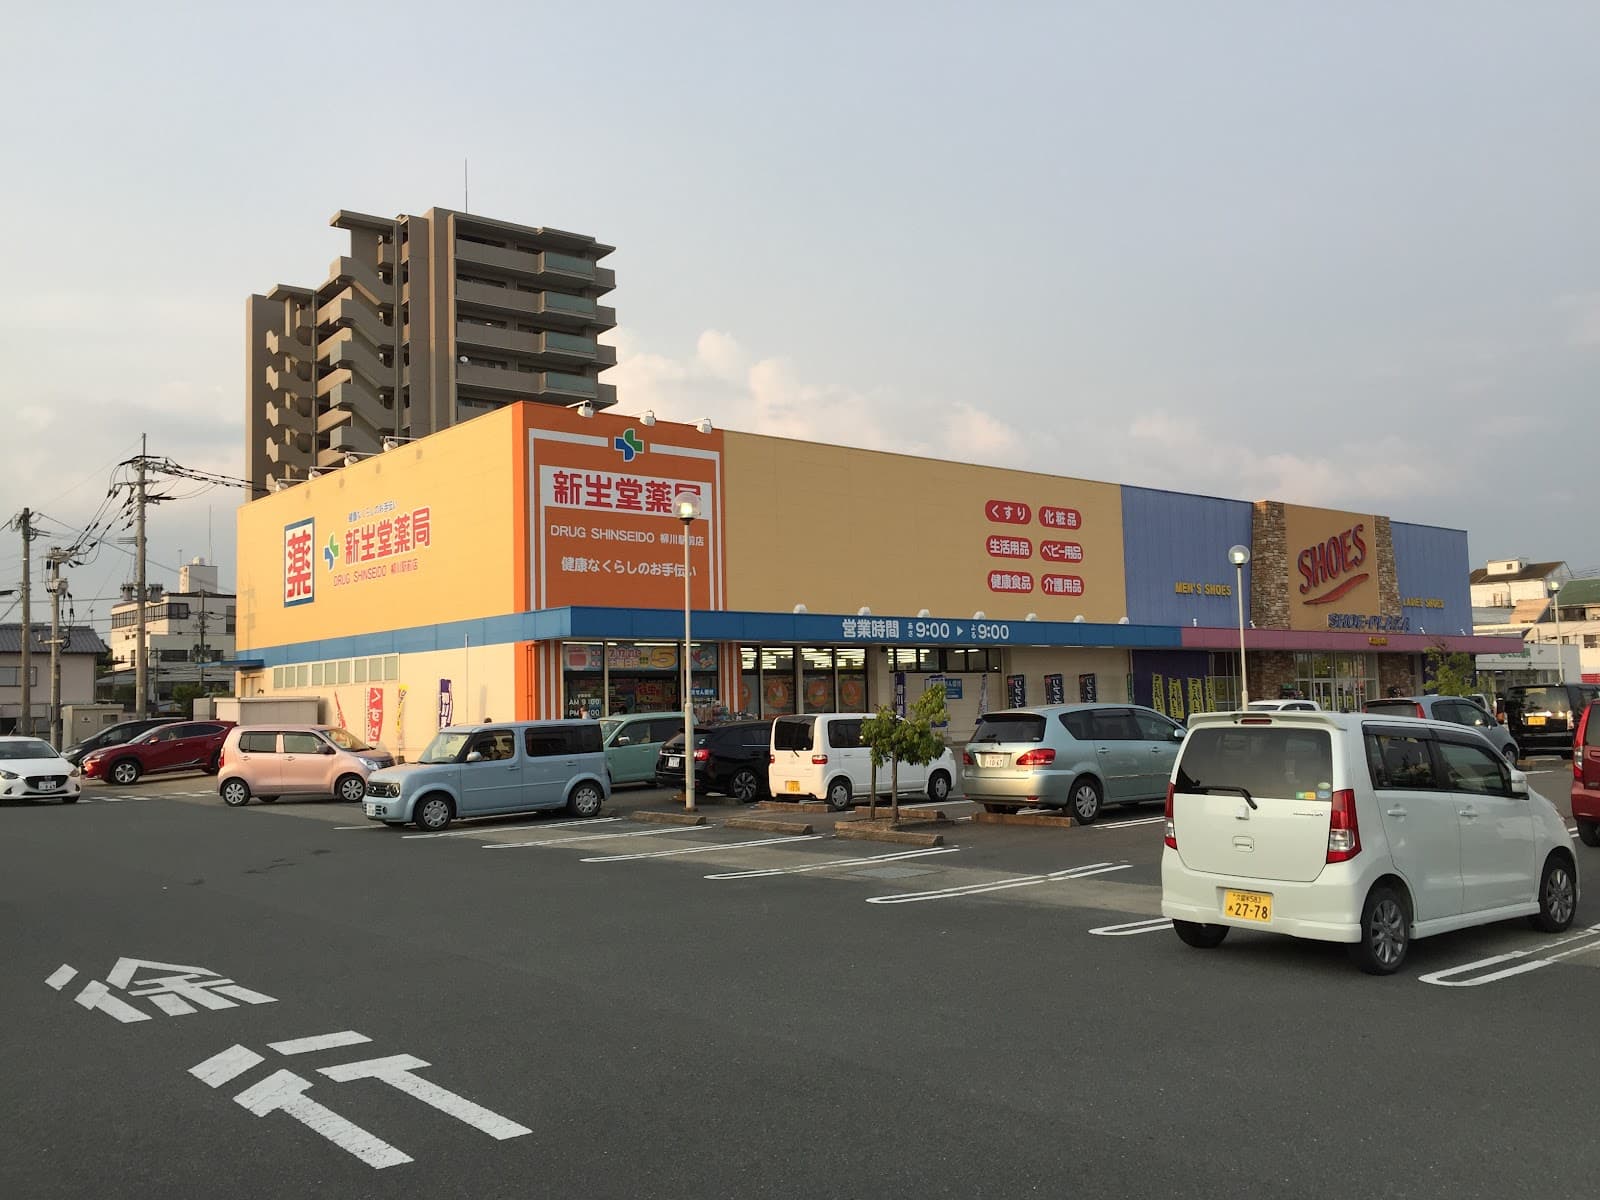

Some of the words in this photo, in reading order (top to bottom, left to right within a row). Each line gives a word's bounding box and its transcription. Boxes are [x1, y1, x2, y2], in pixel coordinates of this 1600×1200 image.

[991, 504, 1026, 520] くすり
[1045, 509, 1077, 527] 化粧品
[345, 507, 431, 565] 新生堂薬局
[550, 524, 586, 538] DRUG
[591, 527, 655, 543] SHINSEIDO
[989, 538, 1030, 556] 生活用品
[1042, 545, 1082, 559] ベビー用品
[286, 529, 312, 598] 薬
[1297, 523, 1367, 594] SHOES
[333, 572, 350, 586] DRUG
[353, 565, 387, 582] SHINSEIDO
[991, 574, 1031, 590] 健康食品
[1044, 577, 1082, 593] 介護用品
[1175, 582, 1202, 595] MEN'S
[1204, 583, 1232, 596] SHOES
[842, 619, 899, 639] 営業時間
[915, 622, 950, 638] 9:00
[977, 624, 1009, 640] 9:00
[568, 698, 579, 706] AM
[569, 709, 579, 717] PM
[1235, 902, 1268, 919] 27-78
[44, 956, 533, 1169] 徐行
